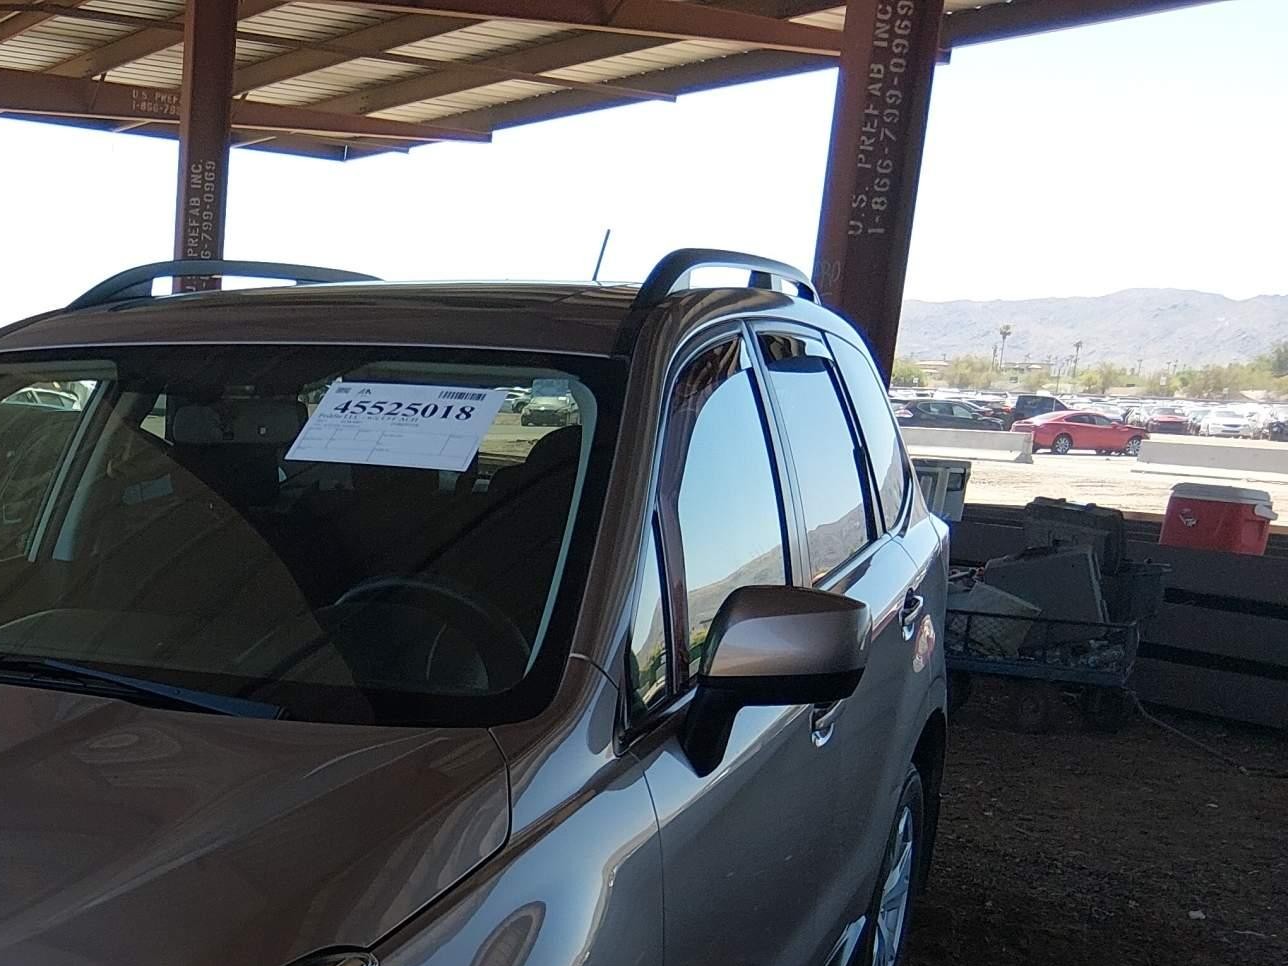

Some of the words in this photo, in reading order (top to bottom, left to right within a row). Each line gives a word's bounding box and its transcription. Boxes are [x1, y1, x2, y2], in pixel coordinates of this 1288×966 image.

[856, 63, 885, 169] PREFAB
[867, 0, 914, 234] 1-866-799-0969
[187, 197, 201, 257] PREFAB
[847, 186, 869, 235] U.S.
[334, 400, 476, 421] 45525018
